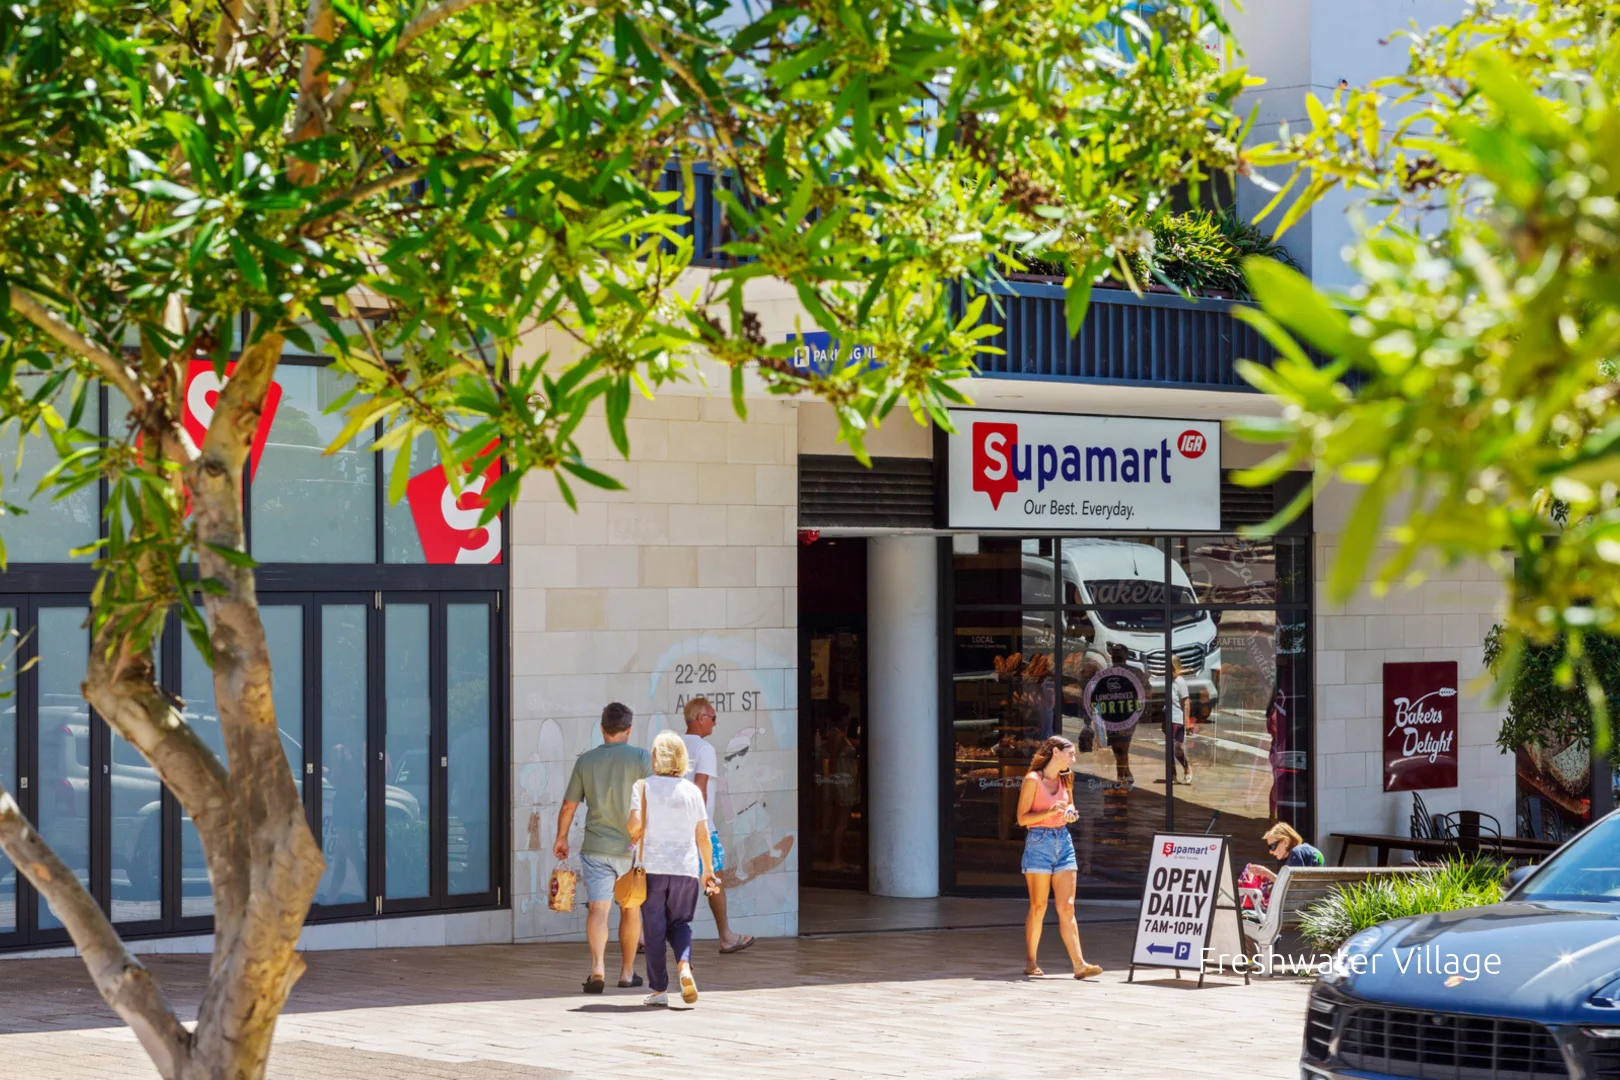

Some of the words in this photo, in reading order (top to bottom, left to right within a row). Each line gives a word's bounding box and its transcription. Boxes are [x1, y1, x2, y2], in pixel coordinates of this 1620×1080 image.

[1180, 435, 1203, 452] IGA
[983, 432, 1171, 493] Supamart
[1024, 500, 1046, 515] Our
[1050, 500, 1078, 515] Best.
[1082, 501, 1135, 520] Everyday.
[675, 663, 717, 684] 22-26
[741, 690, 761, 711] ST
[1090, 698, 1143, 716] SORTED
[1095, 691, 1134, 702] LUNCHBOXES
[1394, 697, 1442, 728] Bakers
[1403, 727, 1454, 763] Delight
[1164, 843, 1208, 855] Supamart
[1152, 867, 1212, 894] OPEN
[1147, 893, 1208, 919] DAILY
[1144, 919, 1204, 936] 7AM-10PM
